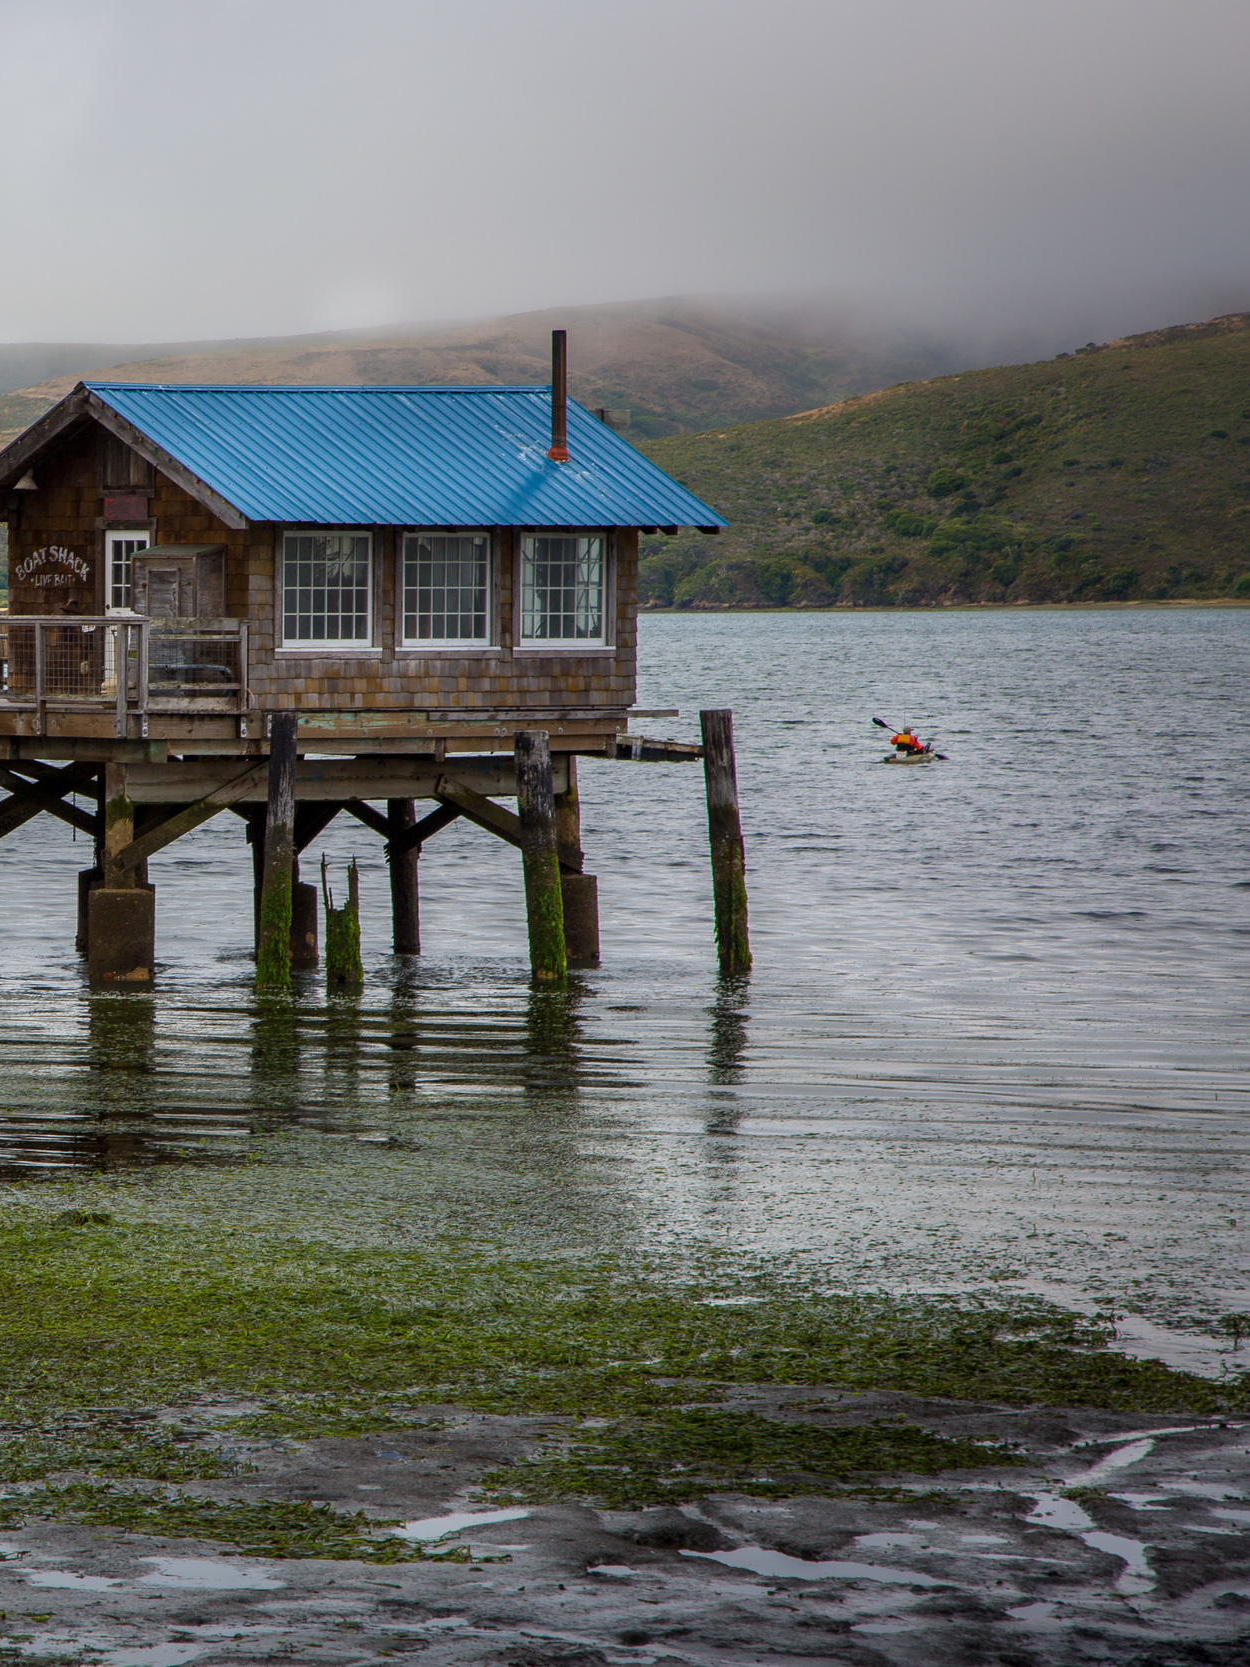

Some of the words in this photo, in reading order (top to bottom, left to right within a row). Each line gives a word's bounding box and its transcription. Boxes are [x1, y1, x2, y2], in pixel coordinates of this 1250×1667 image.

[15, 547, 47, 581] BOAT
[49, 545, 90, 583] SHACK
[35, 574, 53, 586] LIVE
[54, 574, 72, 586] BAIT
